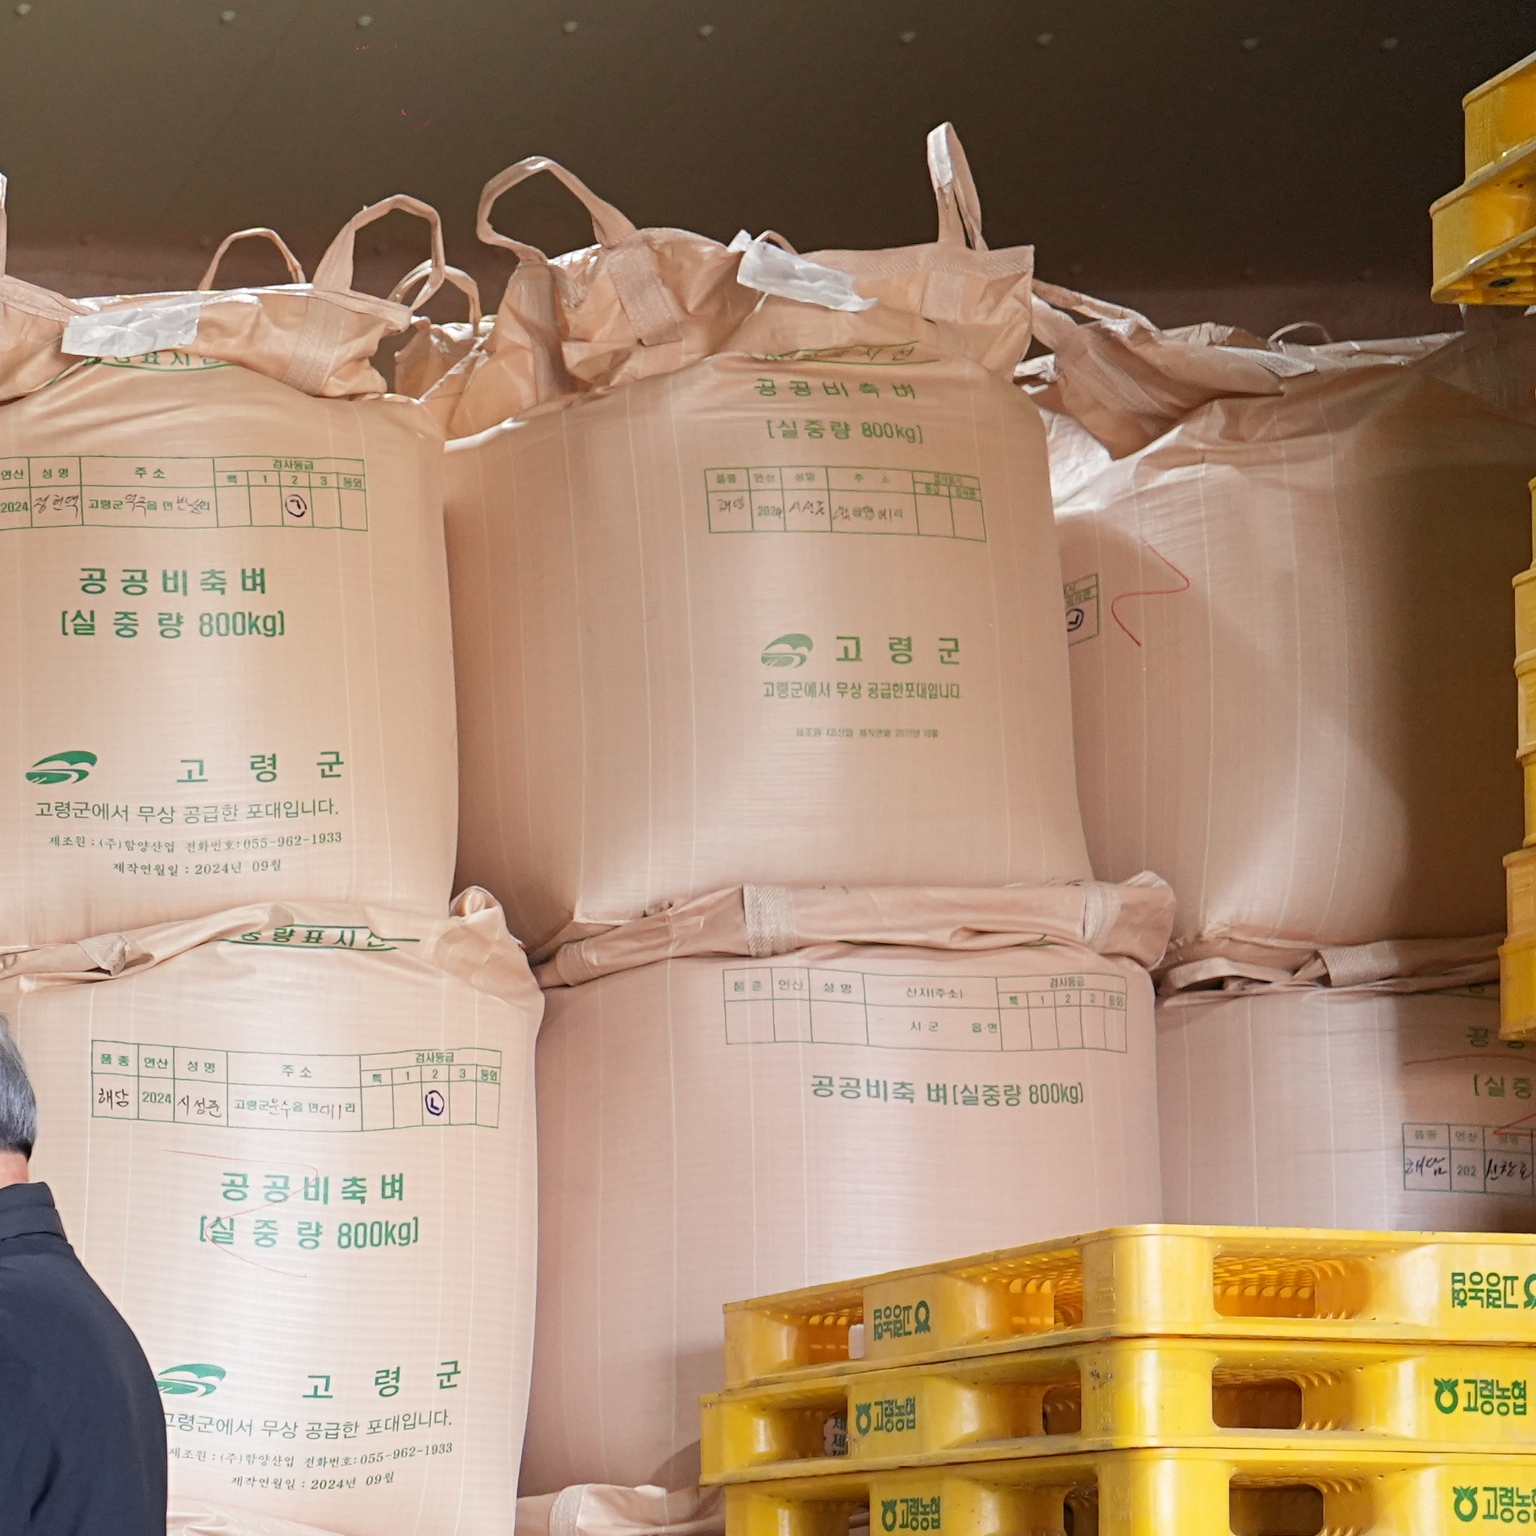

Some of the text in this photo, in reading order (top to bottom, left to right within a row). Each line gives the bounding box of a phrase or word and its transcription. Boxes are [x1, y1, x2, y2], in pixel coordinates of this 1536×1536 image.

[263, 475, 268, 484] 1
[291, 475, 298, 484] 2
[320, 476, 328, 486] 3
[0, 501, 29, 513] 2024
[836, 636, 960, 665] 고령군
[763, 682, 831, 700] 고령군에서
[836, 682, 862, 700] 무상
[177, 751, 344, 783] 고령군
[35, 798, 339, 824] 고령군에서 무상 공급한 포대입니다.
[195, 862, 242, 876] 2024년
[252, 859, 282, 873] 09월
[1065, 994, 1071, 1003] 2
[144, 1057, 168, 1070] 연산
[282, 1064, 312, 1078] 주소
[406, 1071, 410, 1081] 1
[432, 1069, 439, 1079] 2
[459, 1068, 466, 1078] 3
[142, 1091, 172, 1104] 2024
[302, 1360, 461, 1400] 고령군
[1463, 1378, 1527, 1417] 고령농협
[261, 1420, 299, 1440] 무상
[304, 1421, 360, 1441] 공급한
[366, 1409, 453, 1436] 포대입니다.
[311, 1476, 356, 1491] 2024년
[365, 1471, 394, 1487] 09월
